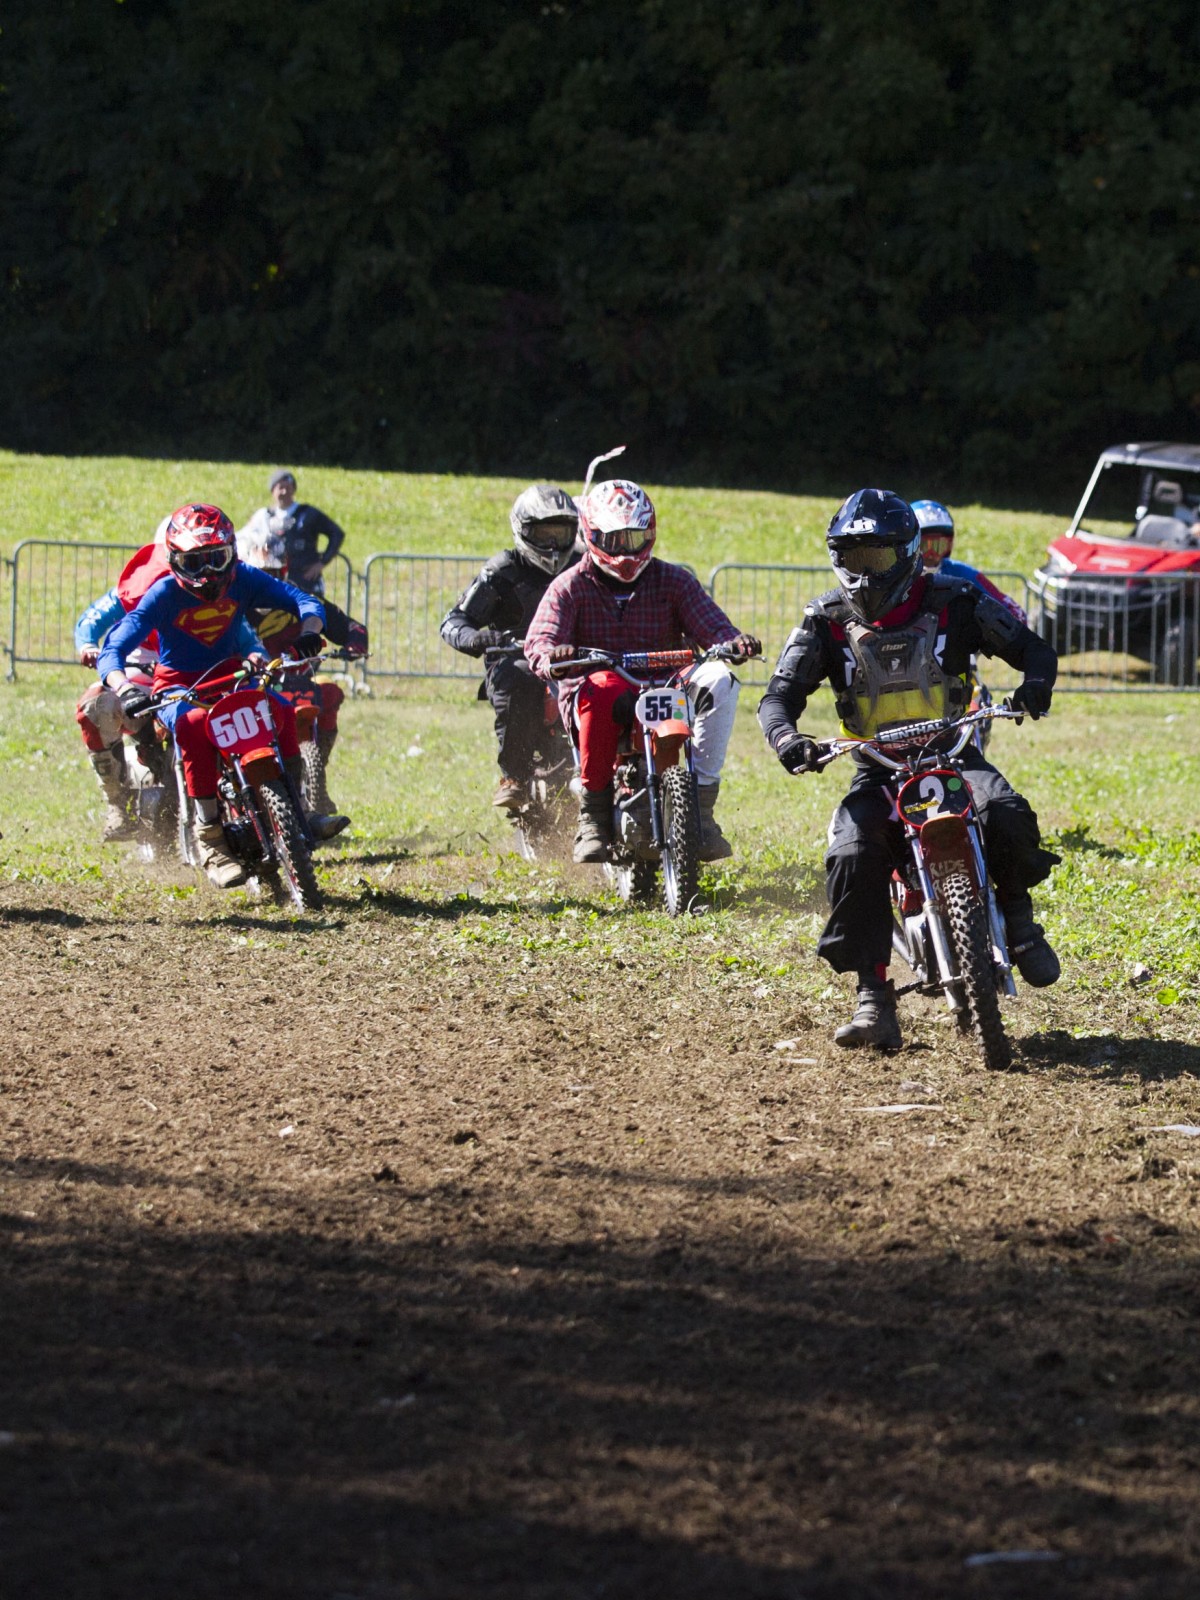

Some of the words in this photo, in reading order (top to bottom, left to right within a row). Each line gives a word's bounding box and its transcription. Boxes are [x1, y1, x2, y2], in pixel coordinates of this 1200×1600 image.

[210, 699, 273, 748] 501
[645, 695, 673, 722] 55
[880, 722, 944, 742] RENTHAL
[919, 775, 951, 820] 2
